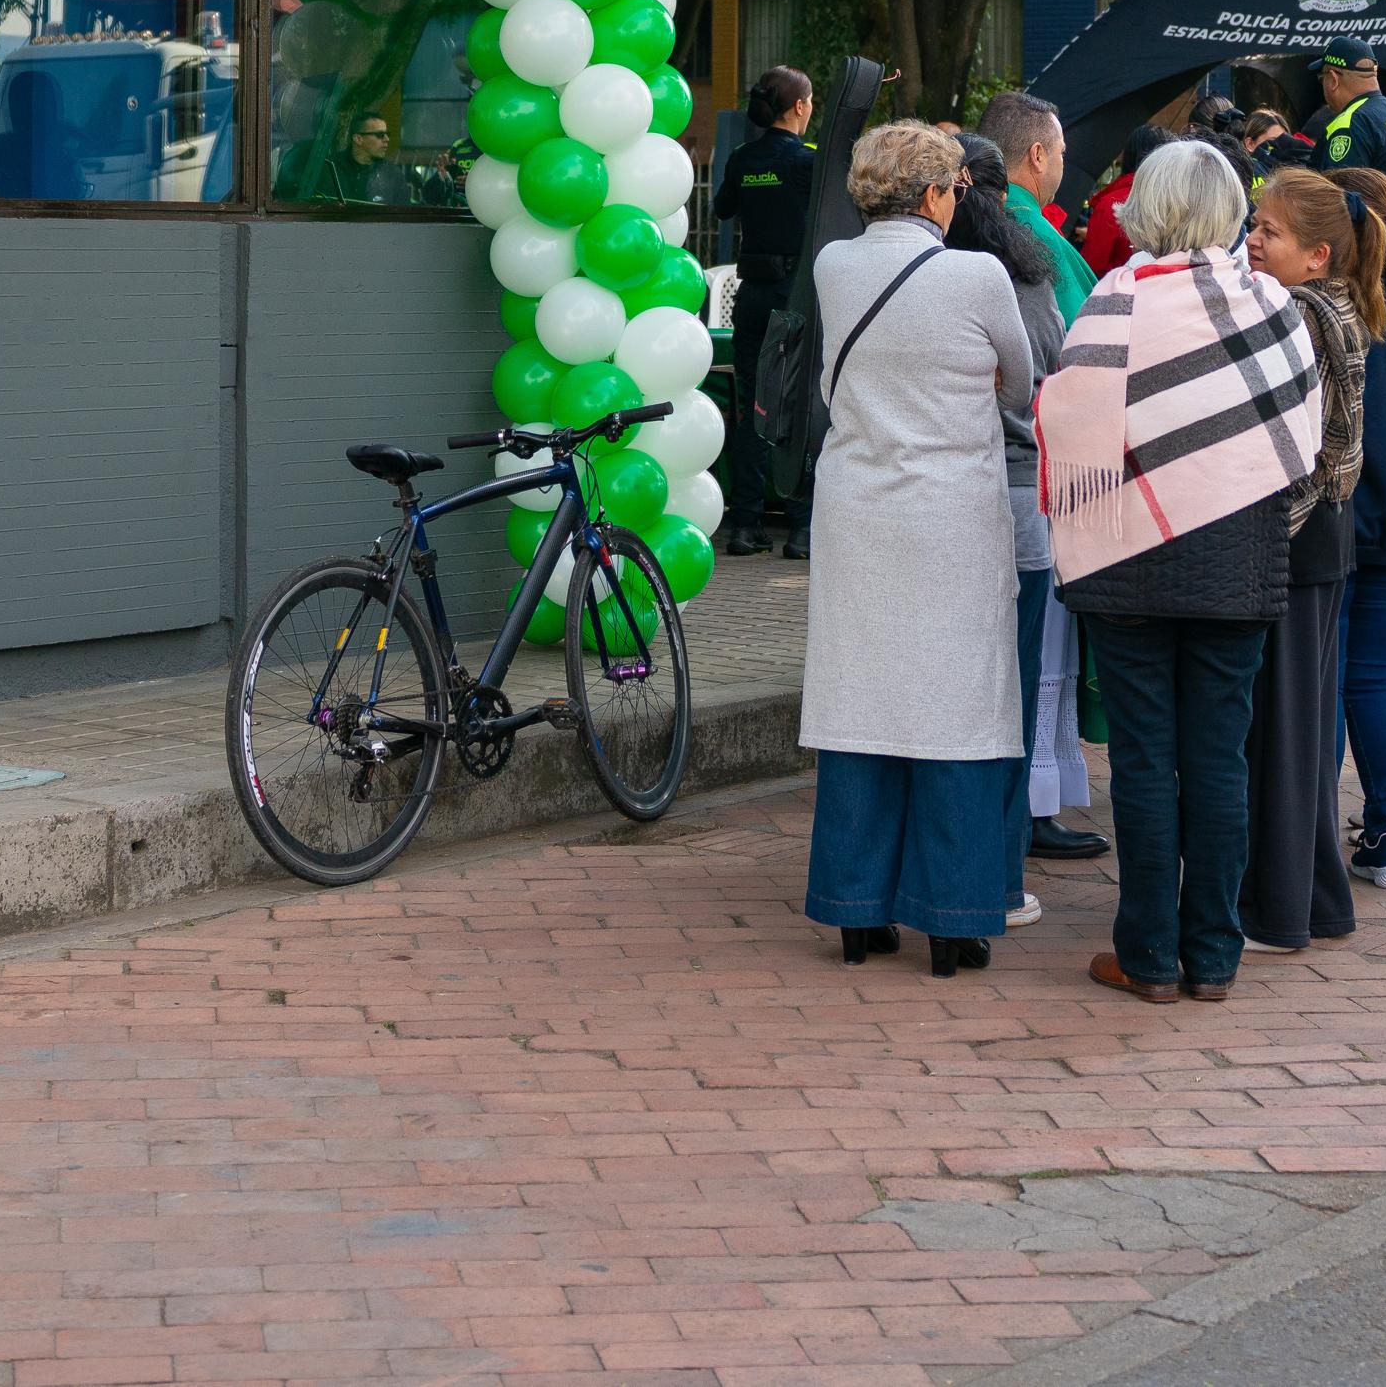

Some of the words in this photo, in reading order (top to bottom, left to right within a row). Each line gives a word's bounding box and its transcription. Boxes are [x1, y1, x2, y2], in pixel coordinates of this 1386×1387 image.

[1216, 11, 1290, 31] POLICÍA
[1162, 24, 1254, 44] ESTACIÓN
[1257, 33, 1284, 46] DE
[743, 171, 778, 183] POLICÍA
